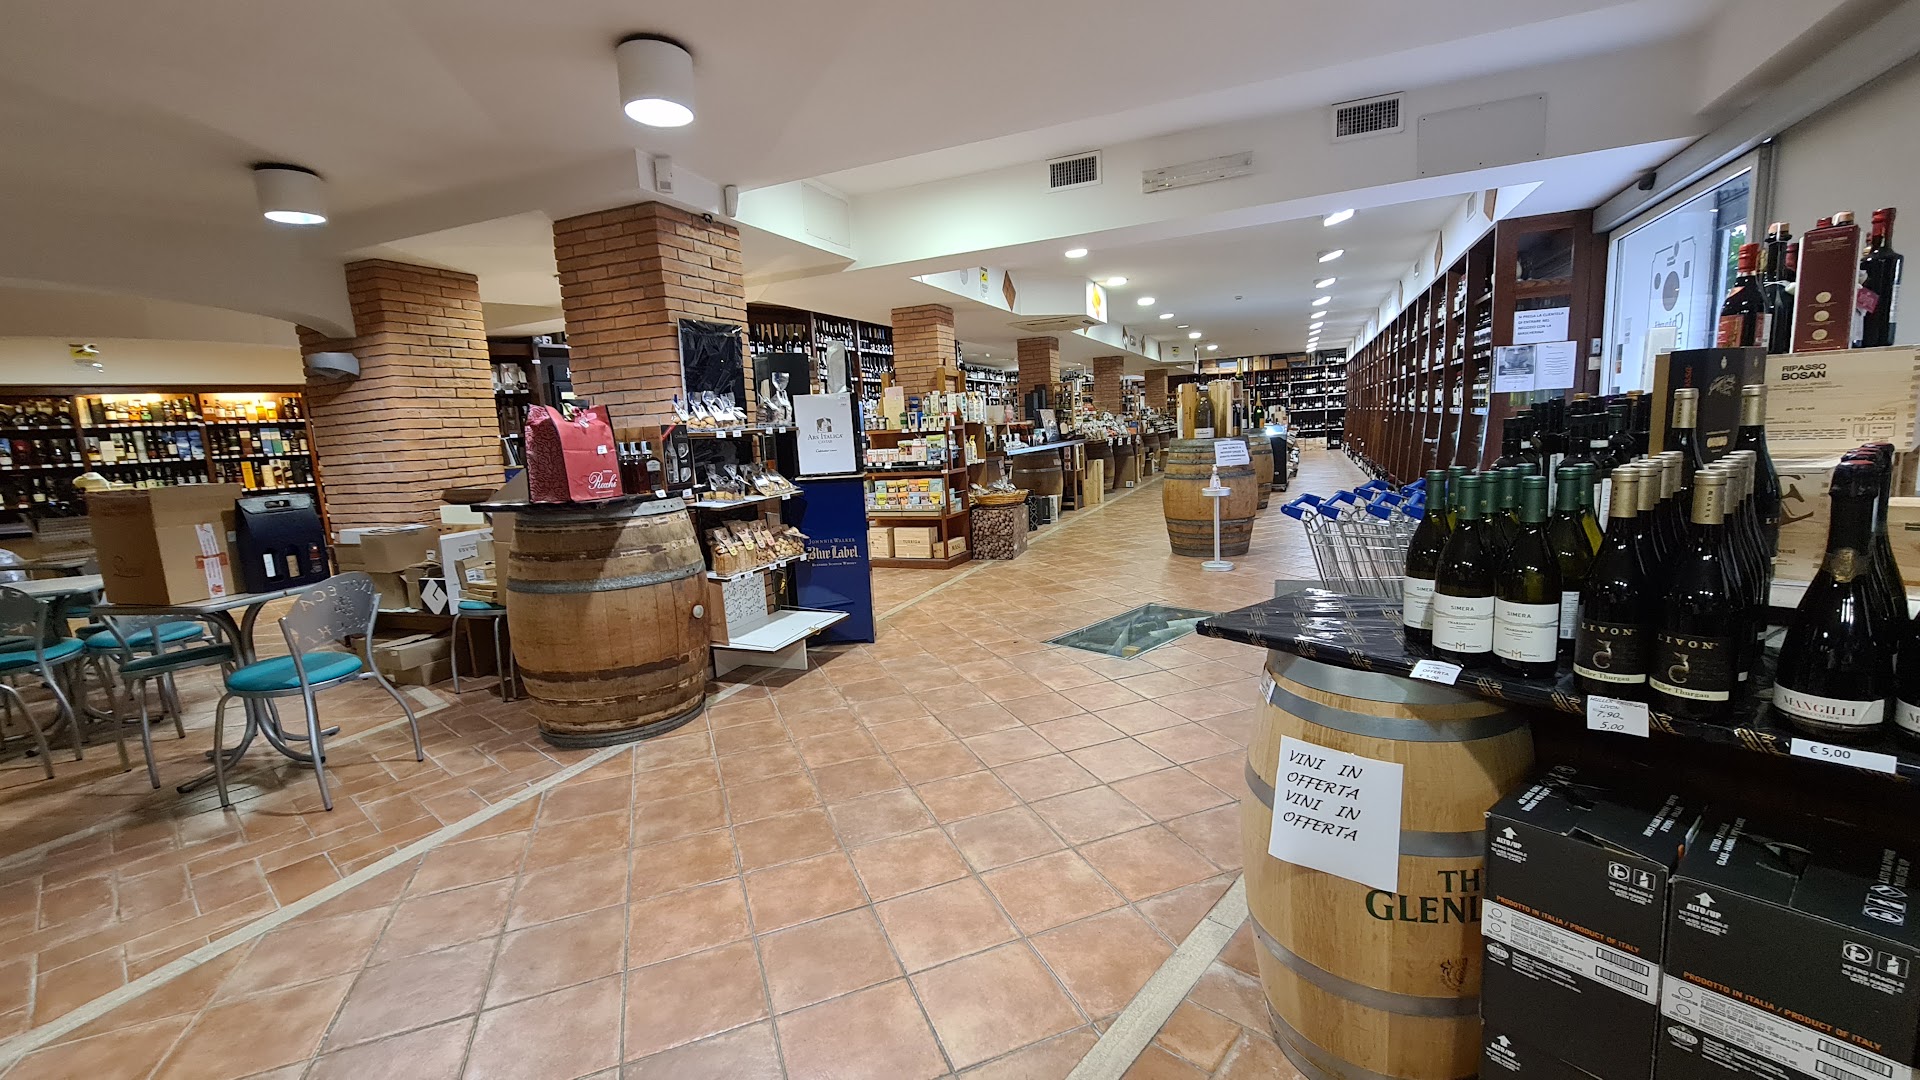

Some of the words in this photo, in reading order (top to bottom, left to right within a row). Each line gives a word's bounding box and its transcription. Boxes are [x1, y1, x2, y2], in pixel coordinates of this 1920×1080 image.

[1782, 363, 1826, 372] RIPASSO
[1782, 371, 1826, 380] BOSAN
[1704, 490, 1713, 518] LIVON
[806, 546, 831, 560] Blue
[1581, 622, 1632, 636] LIVON
[1657, 633, 1714, 650] LIVON
[1600, 672, 1630, 682] Thurgau
[1674, 687, 1710, 699] Thurgau
[1784, 696, 1855, 716] MANGILLI
[1908, 712, 1920, 723] M
[1810, 745, 1818, 754] €
[1822, 747, 1851, 759] 5,00
[1289, 750, 1326, 770] VINI
[1337, 764, 1363, 779] IN
[1287, 772, 1360, 800] OFFERTA
[1285, 789, 1324, 811] VINI
[1335, 805, 1361, 820] IN
[1283, 812, 1358, 841] OFFERTA
[1438, 868, 1484, 893] TH
[1365, 889, 1482, 923] GLENL
[1686, 903, 1721, 919] ALTO/UP
[1497, 895, 1530, 913] PRODOTTO
[1532, 908, 1540, 916] IN
[1542, 912, 1564, 925] ITALIA
[1570, 923, 1605, 940] PRODUCT
[1606, 936, 1616, 944] OF
[1618, 941, 1640, 954] ITALY
[1684, 971, 1730, 992] PRODOTTO
[1732, 990, 1742, 998] IN
[1745, 993, 1775, 1011] ITALIA
[1784, 1008, 1833, 1032] PRODUCT
[1836, 1028, 1849, 1038] OF
[1851, 1034, 1882, 1050] ITALY
